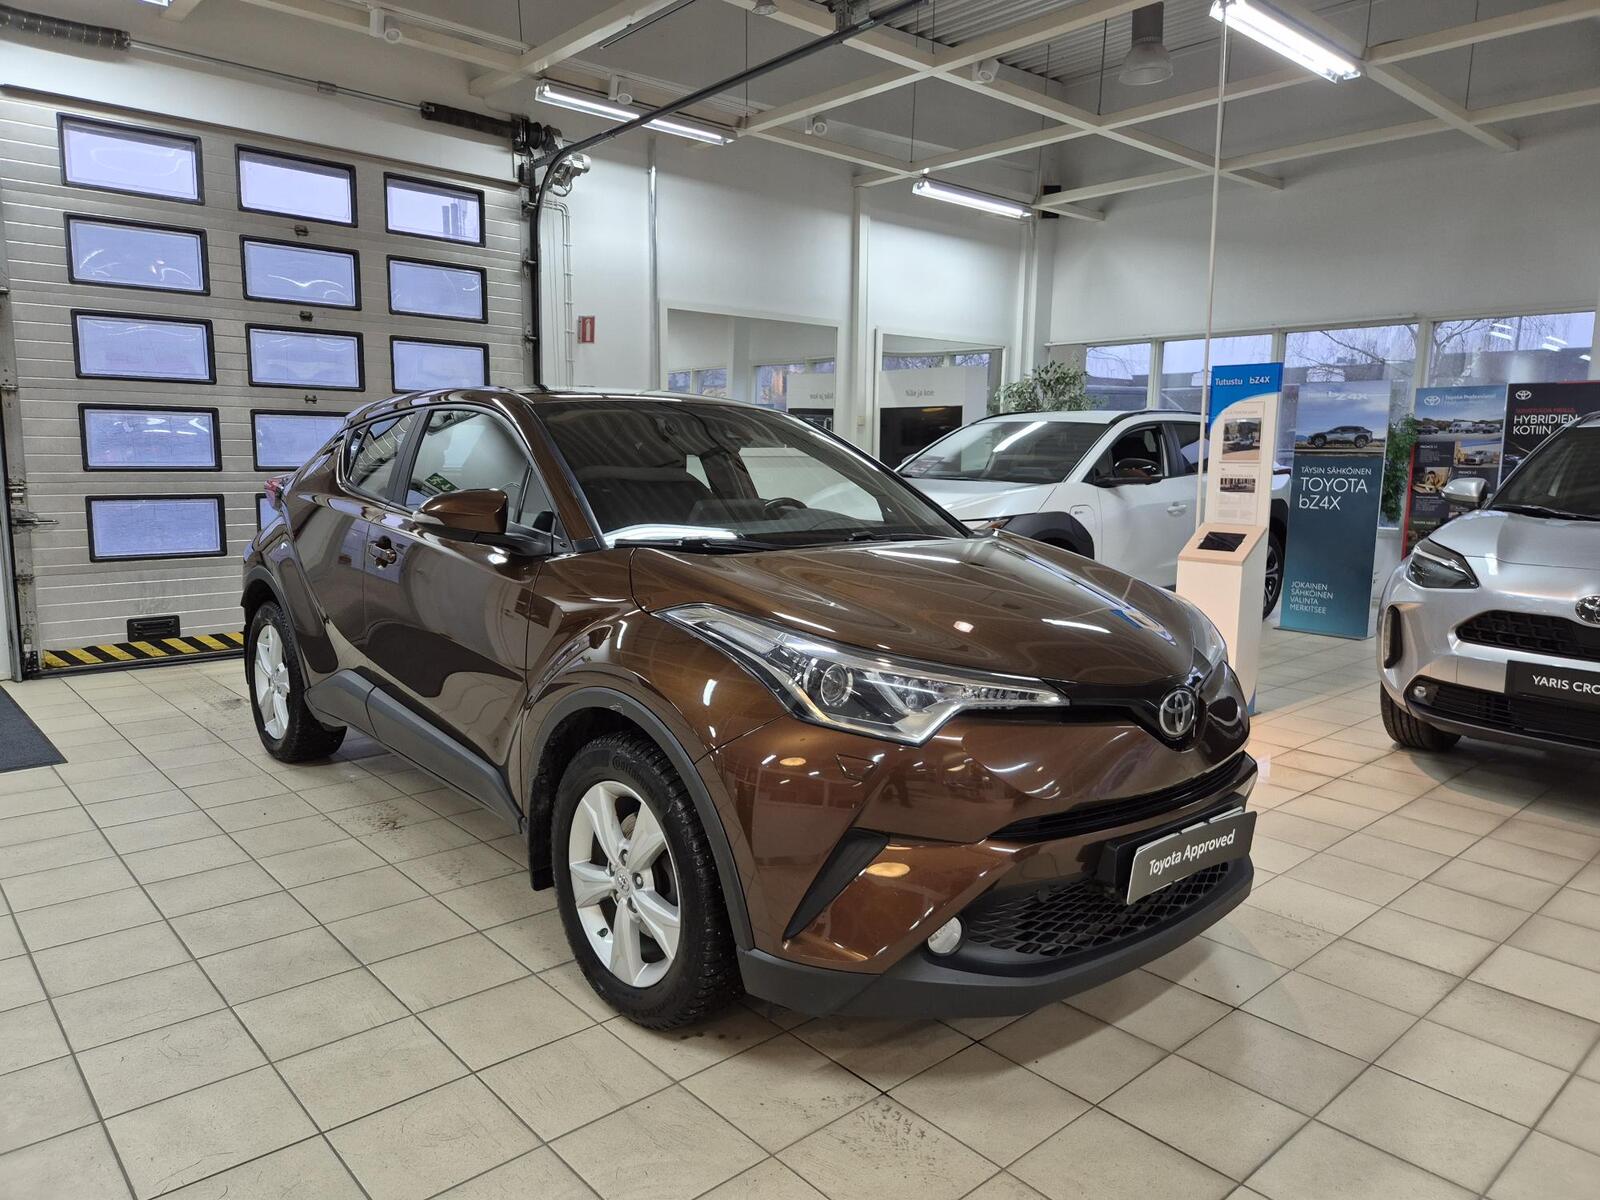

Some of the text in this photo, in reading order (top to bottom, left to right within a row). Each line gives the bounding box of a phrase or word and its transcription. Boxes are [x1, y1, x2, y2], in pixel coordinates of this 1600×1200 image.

[1215, 376, 1270, 386] Tutustu bZ4X
[1514, 414, 1579, 425] HYBRIDIEN
[1512, 425, 1552, 435] KOTIIN
[1301, 466, 1372, 476] TÄYSIN SÄHKÖINEN
[1300, 477, 1368, 494] TOYOTA
[1299, 494, 1342, 511] bZ4X
[1291, 581, 1328, 591] JOKAINEN
[1290, 596, 1319, 605] VALINTA
[1290, 603, 1327, 615] MERKITSEE
[1532, 674, 1570, 690] YARIS
[1148, 828, 1236, 876] Toyota Approved
